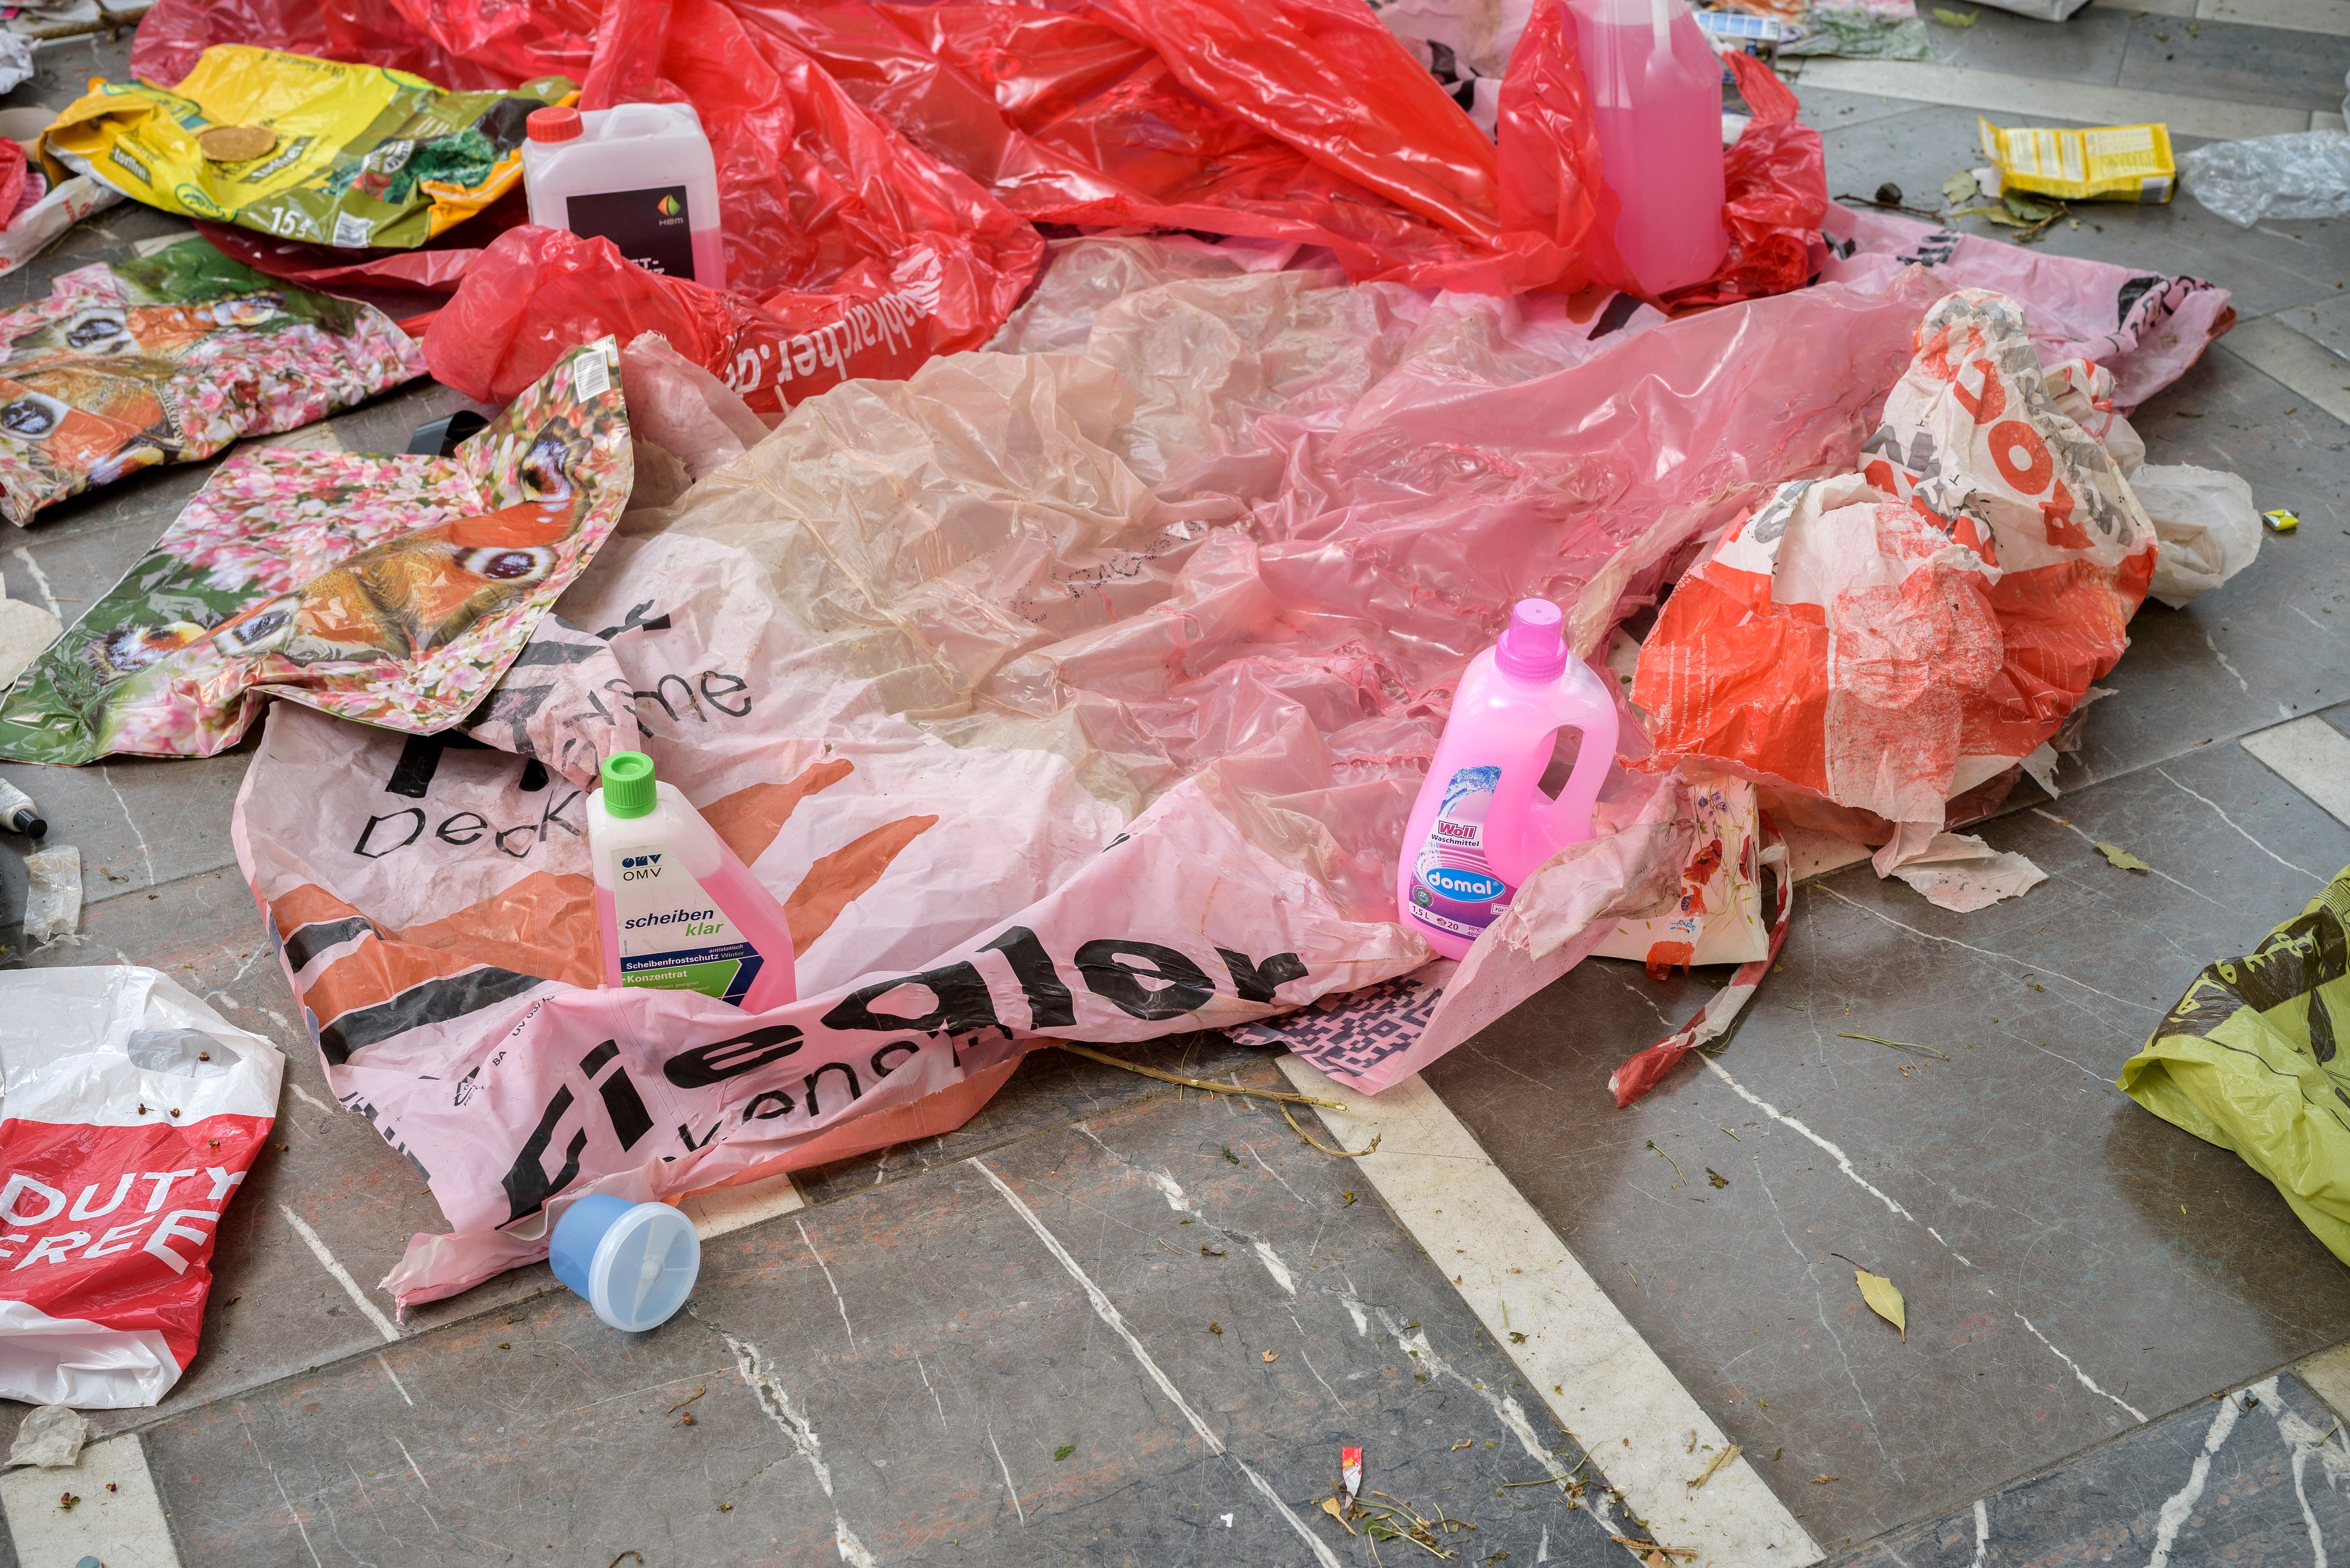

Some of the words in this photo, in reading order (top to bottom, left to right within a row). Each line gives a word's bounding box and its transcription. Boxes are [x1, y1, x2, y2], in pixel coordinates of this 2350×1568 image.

[270, 207, 301, 235] 15
[1697, 695, 1706, 716] travail
[1438, 820, 1476, 839] Woll
[1431, 834, 1480, 847] Waschmittel
[622, 867, 662, 881] OMV
[624, 909, 714, 930] scheiben
[1411, 905, 1423, 916] 1,5
[1425, 912, 1430, 920] L
[1447, 922, 1459, 931] 20
[685, 922, 724, 937] klar
[708, 944, 743, 954] antistatisch
[626, 953, 719, 970] Scheibenfrostschutz
[720, 950, 745, 959] Winter
[675, 981, 699, 989] geeignet
[492, 1050, 507, 1067] BA
[512, 1020, 526, 1036] UV
[0, 1166, 248, 1226] DUTY
